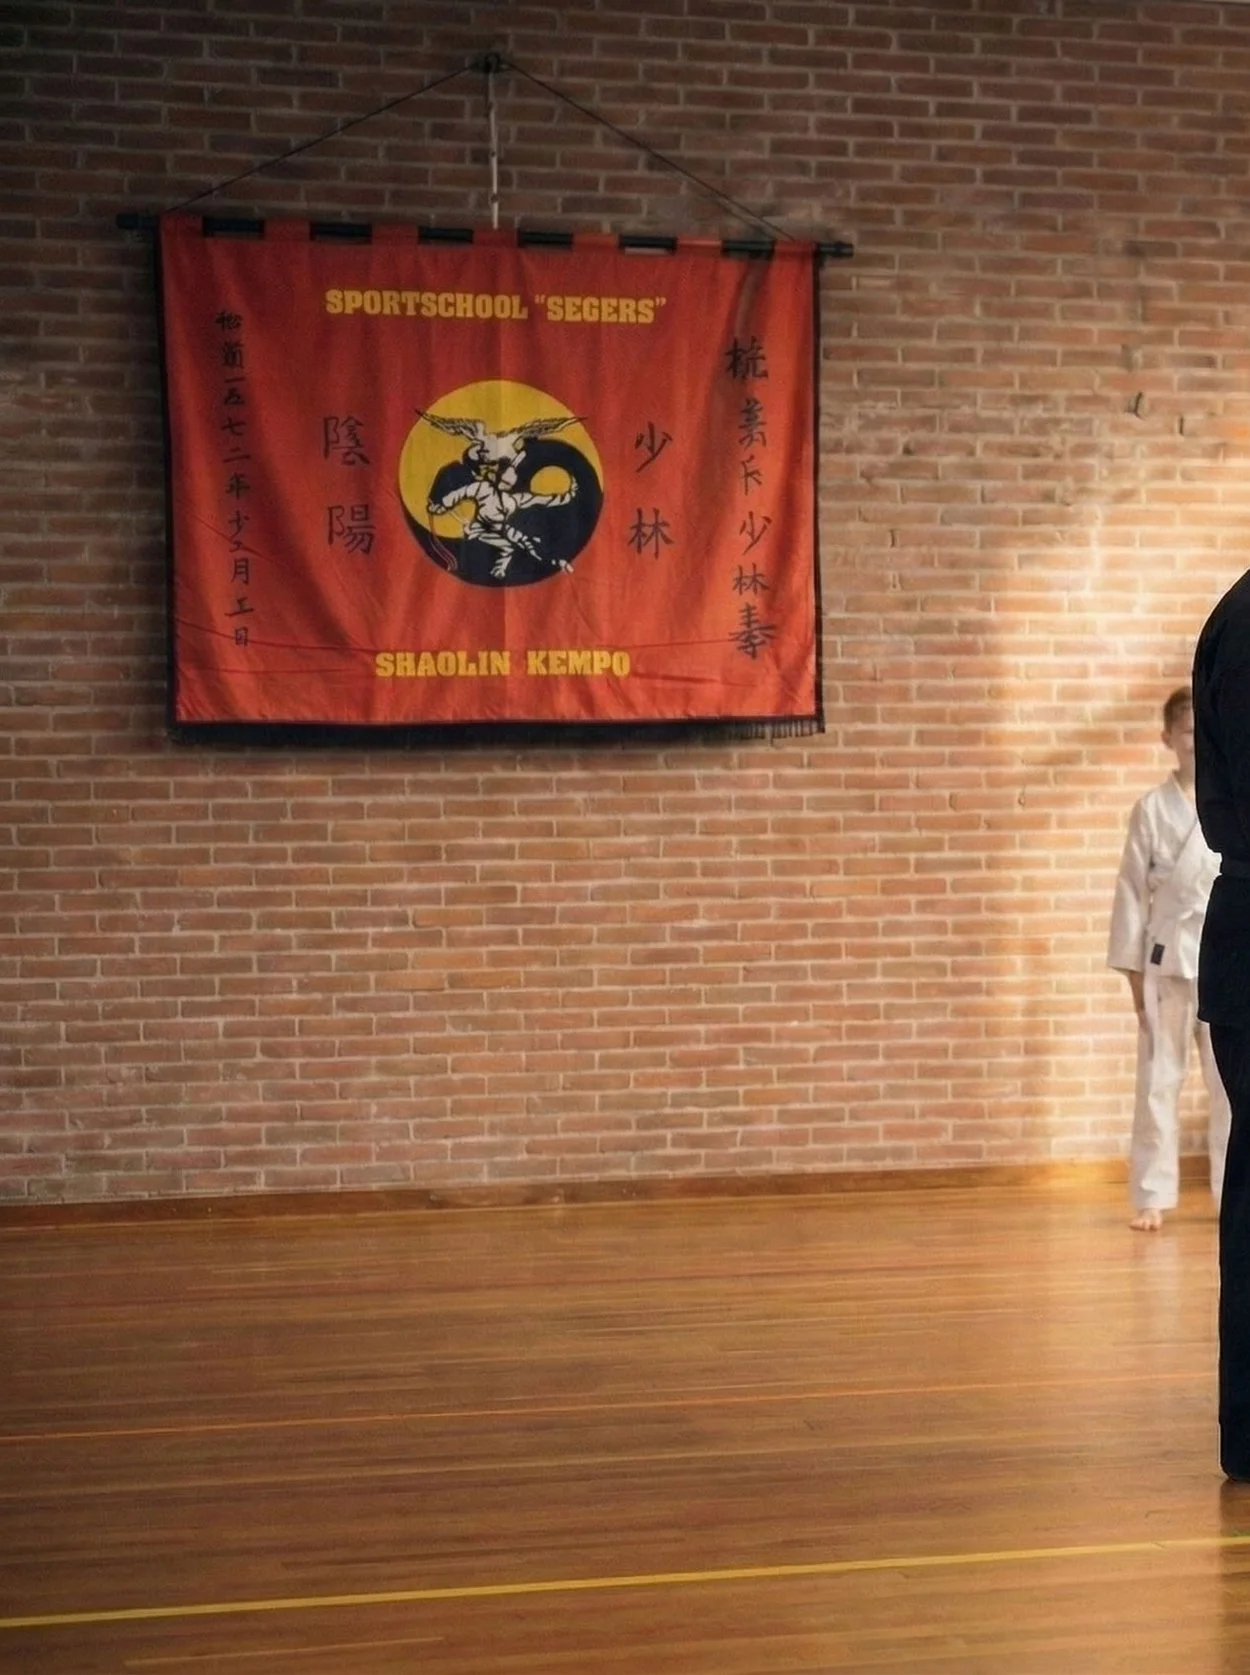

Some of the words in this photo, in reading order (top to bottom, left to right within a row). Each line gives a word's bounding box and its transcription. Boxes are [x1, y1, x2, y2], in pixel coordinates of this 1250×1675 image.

[325, 288, 528, 319] SPORTSCHOOL
[534, 294, 667, 324] “SEGERS”
[627, 421, 675, 561] 少林
[375, 651, 511, 677] SHAOLIN
[527, 650, 631, 677] KEMPO
